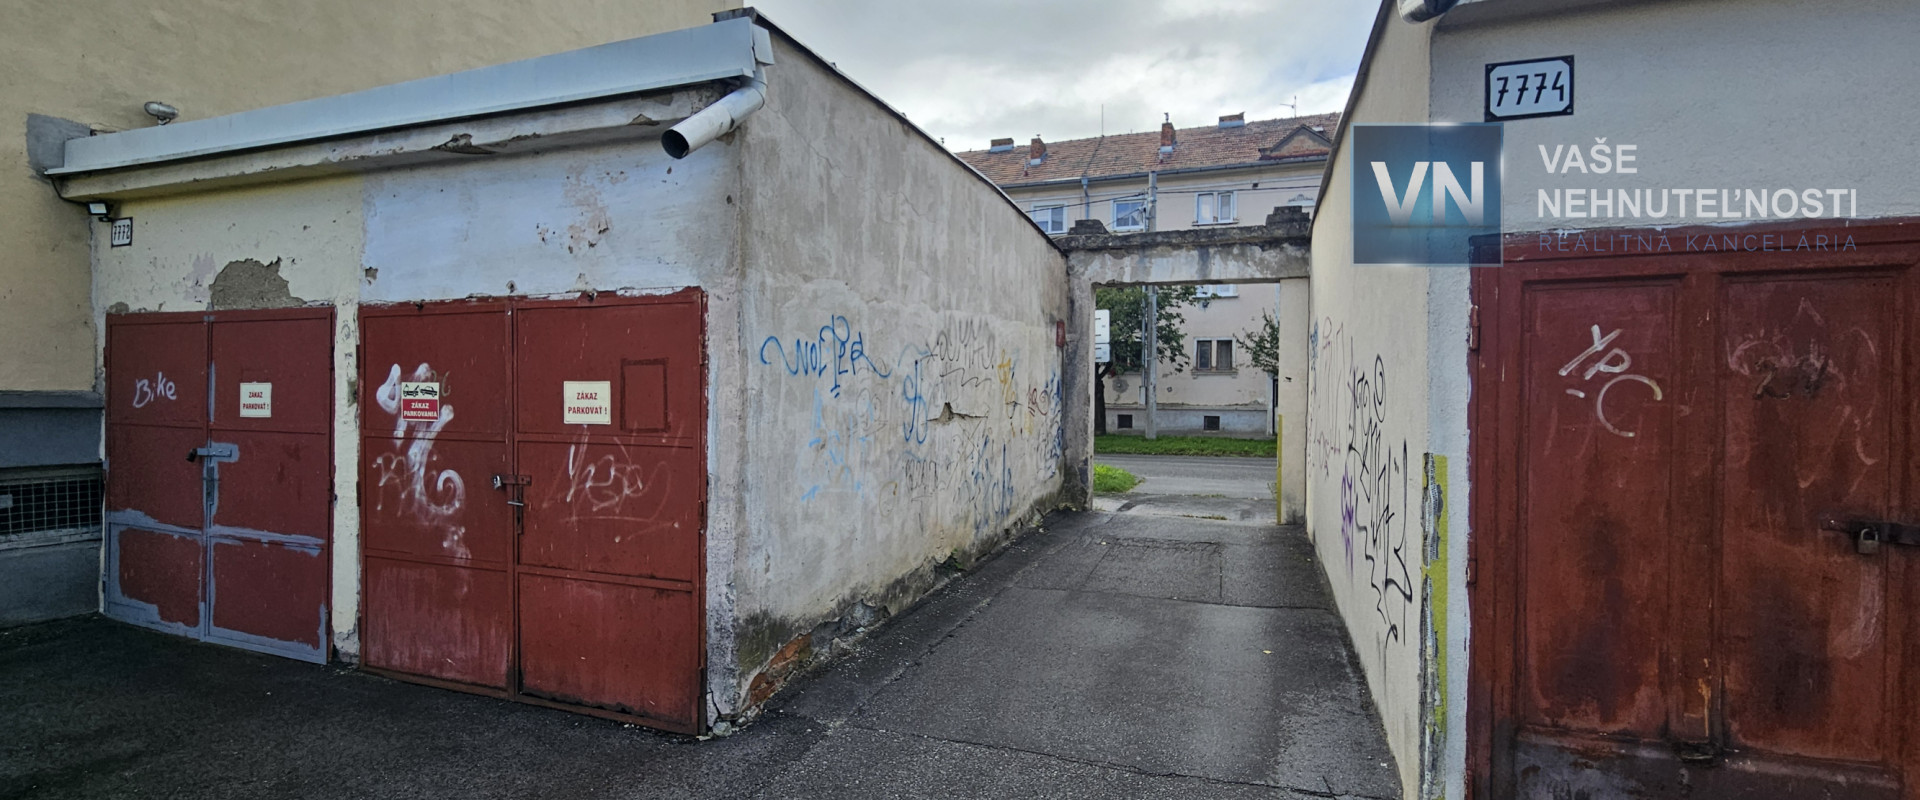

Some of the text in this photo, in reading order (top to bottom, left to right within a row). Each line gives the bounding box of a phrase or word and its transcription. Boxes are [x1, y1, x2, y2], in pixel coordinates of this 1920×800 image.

[1496, 70, 1564, 107] 7774
[113, 224, 130, 241] 7772
[132, 371, 177, 408] Bike
[411, 401, 430, 409] ZÁKAZ
